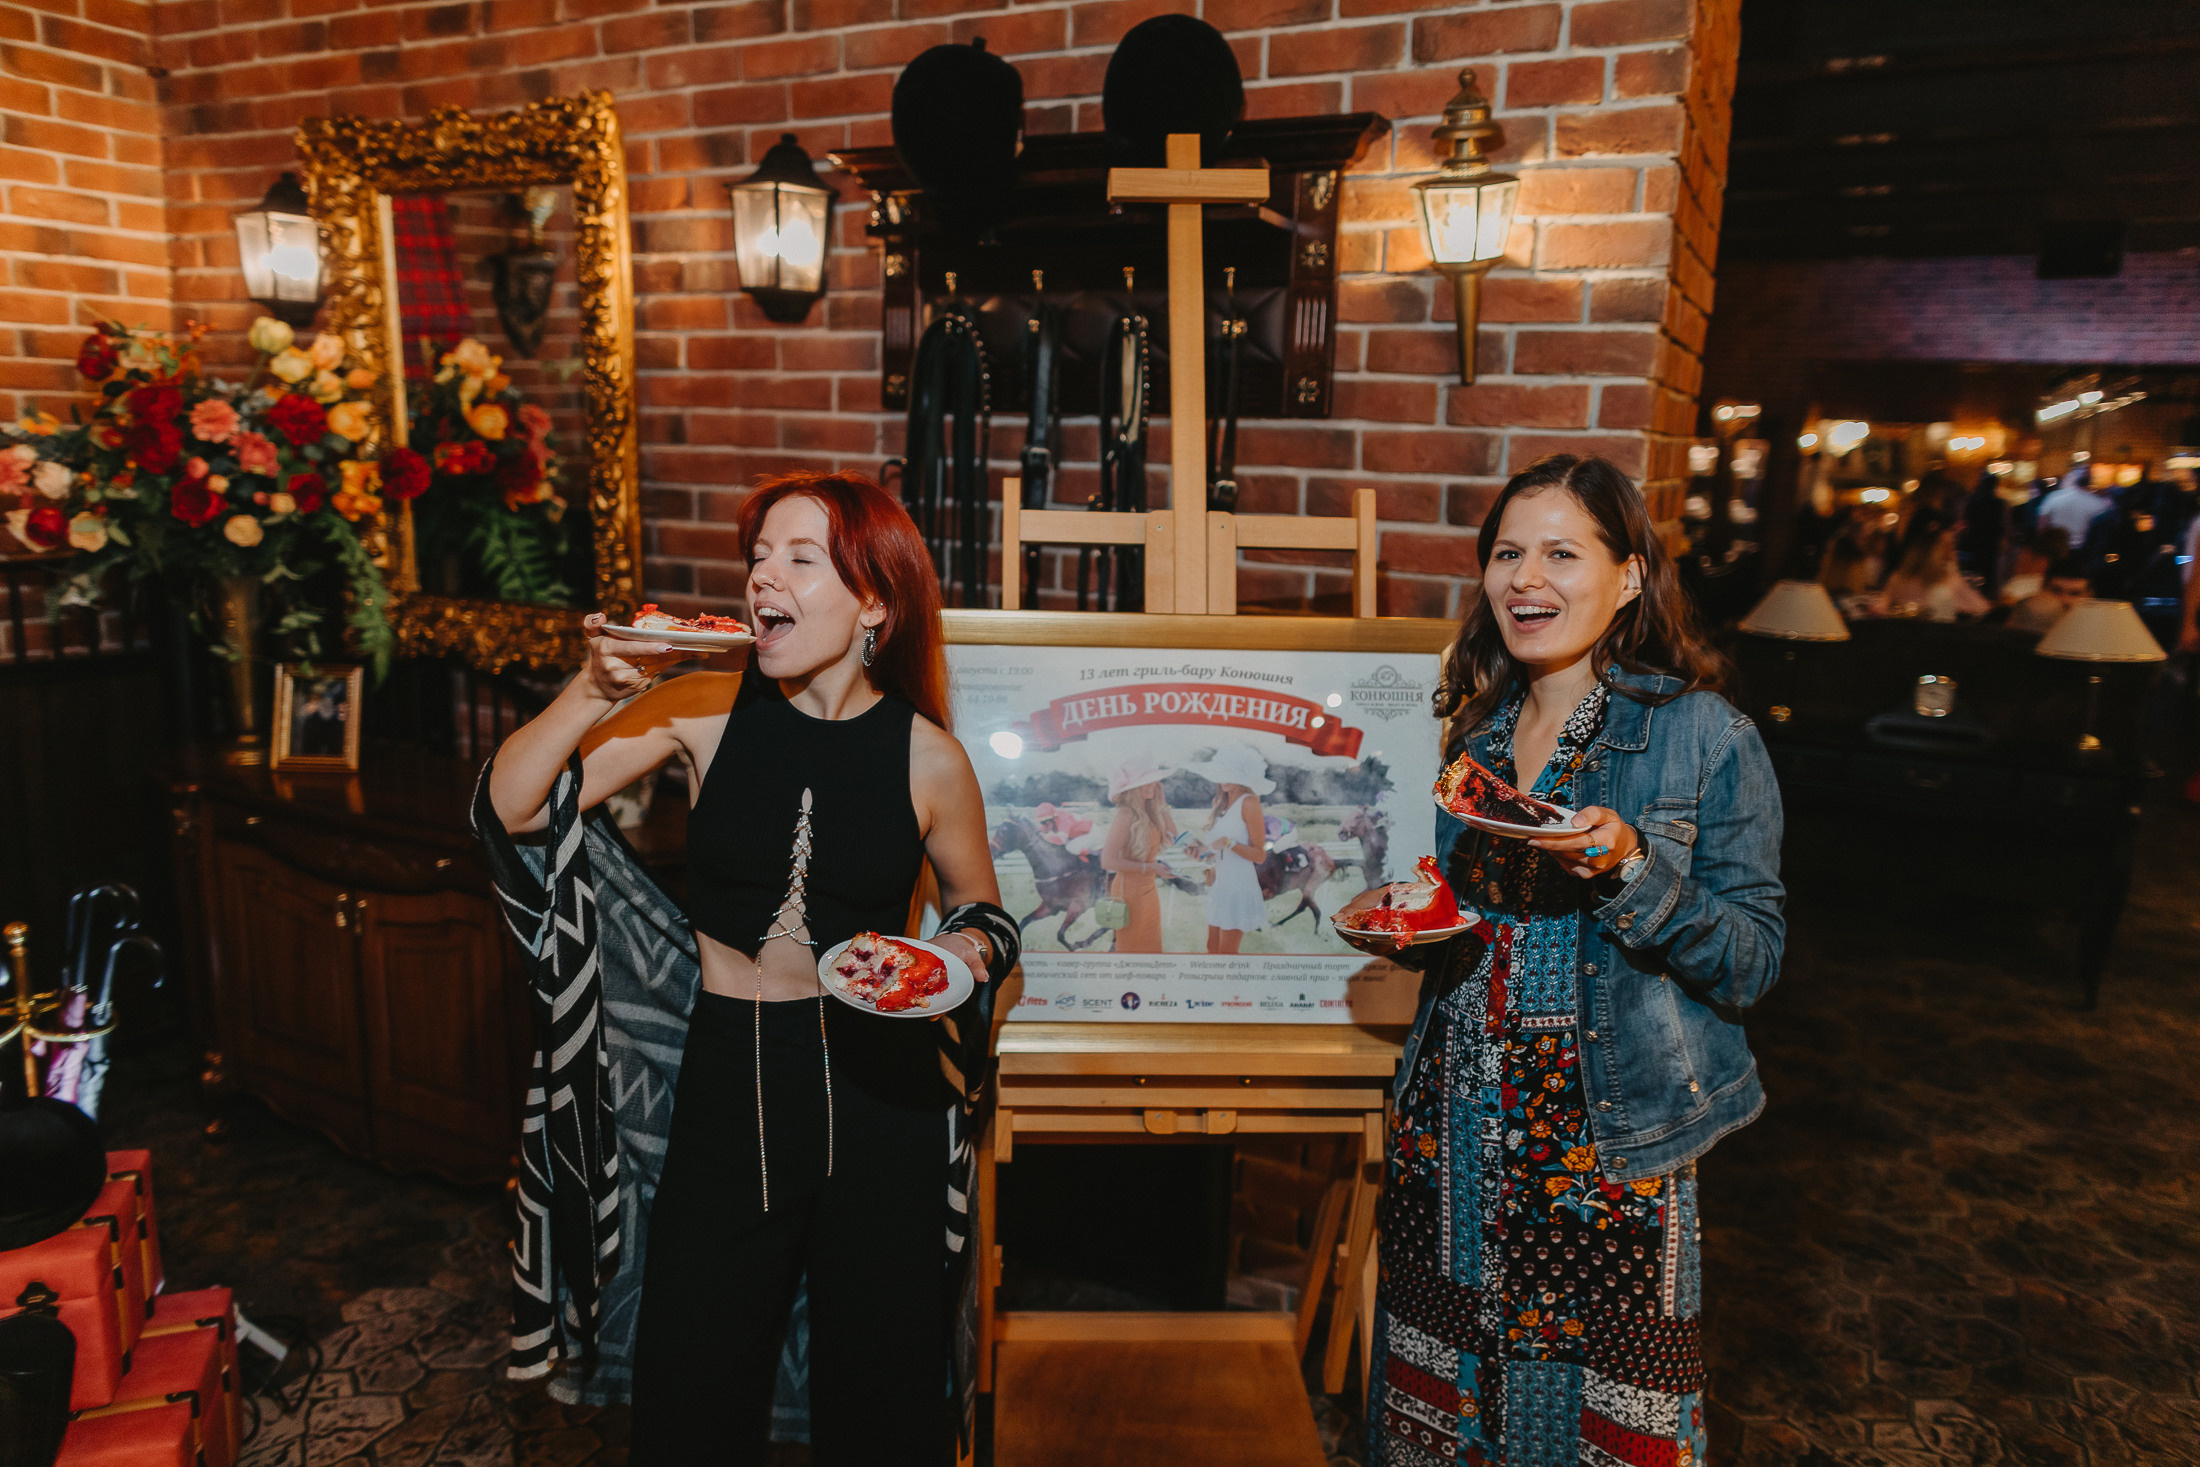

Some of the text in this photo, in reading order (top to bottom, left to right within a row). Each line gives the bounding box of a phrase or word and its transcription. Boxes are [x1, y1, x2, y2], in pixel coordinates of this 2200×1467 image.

[1080, 664, 1294, 685] 13 лет гриль-бару Конюшня
[1350, 690, 1423, 702] КОНЮШНЯ
[1062, 691, 1310, 730] ДЕНЬ РОЖДЕНИЯ
[1190, 961, 1250, 970] Welcome drink
[1083, 999, 1113, 1007] SCENT
